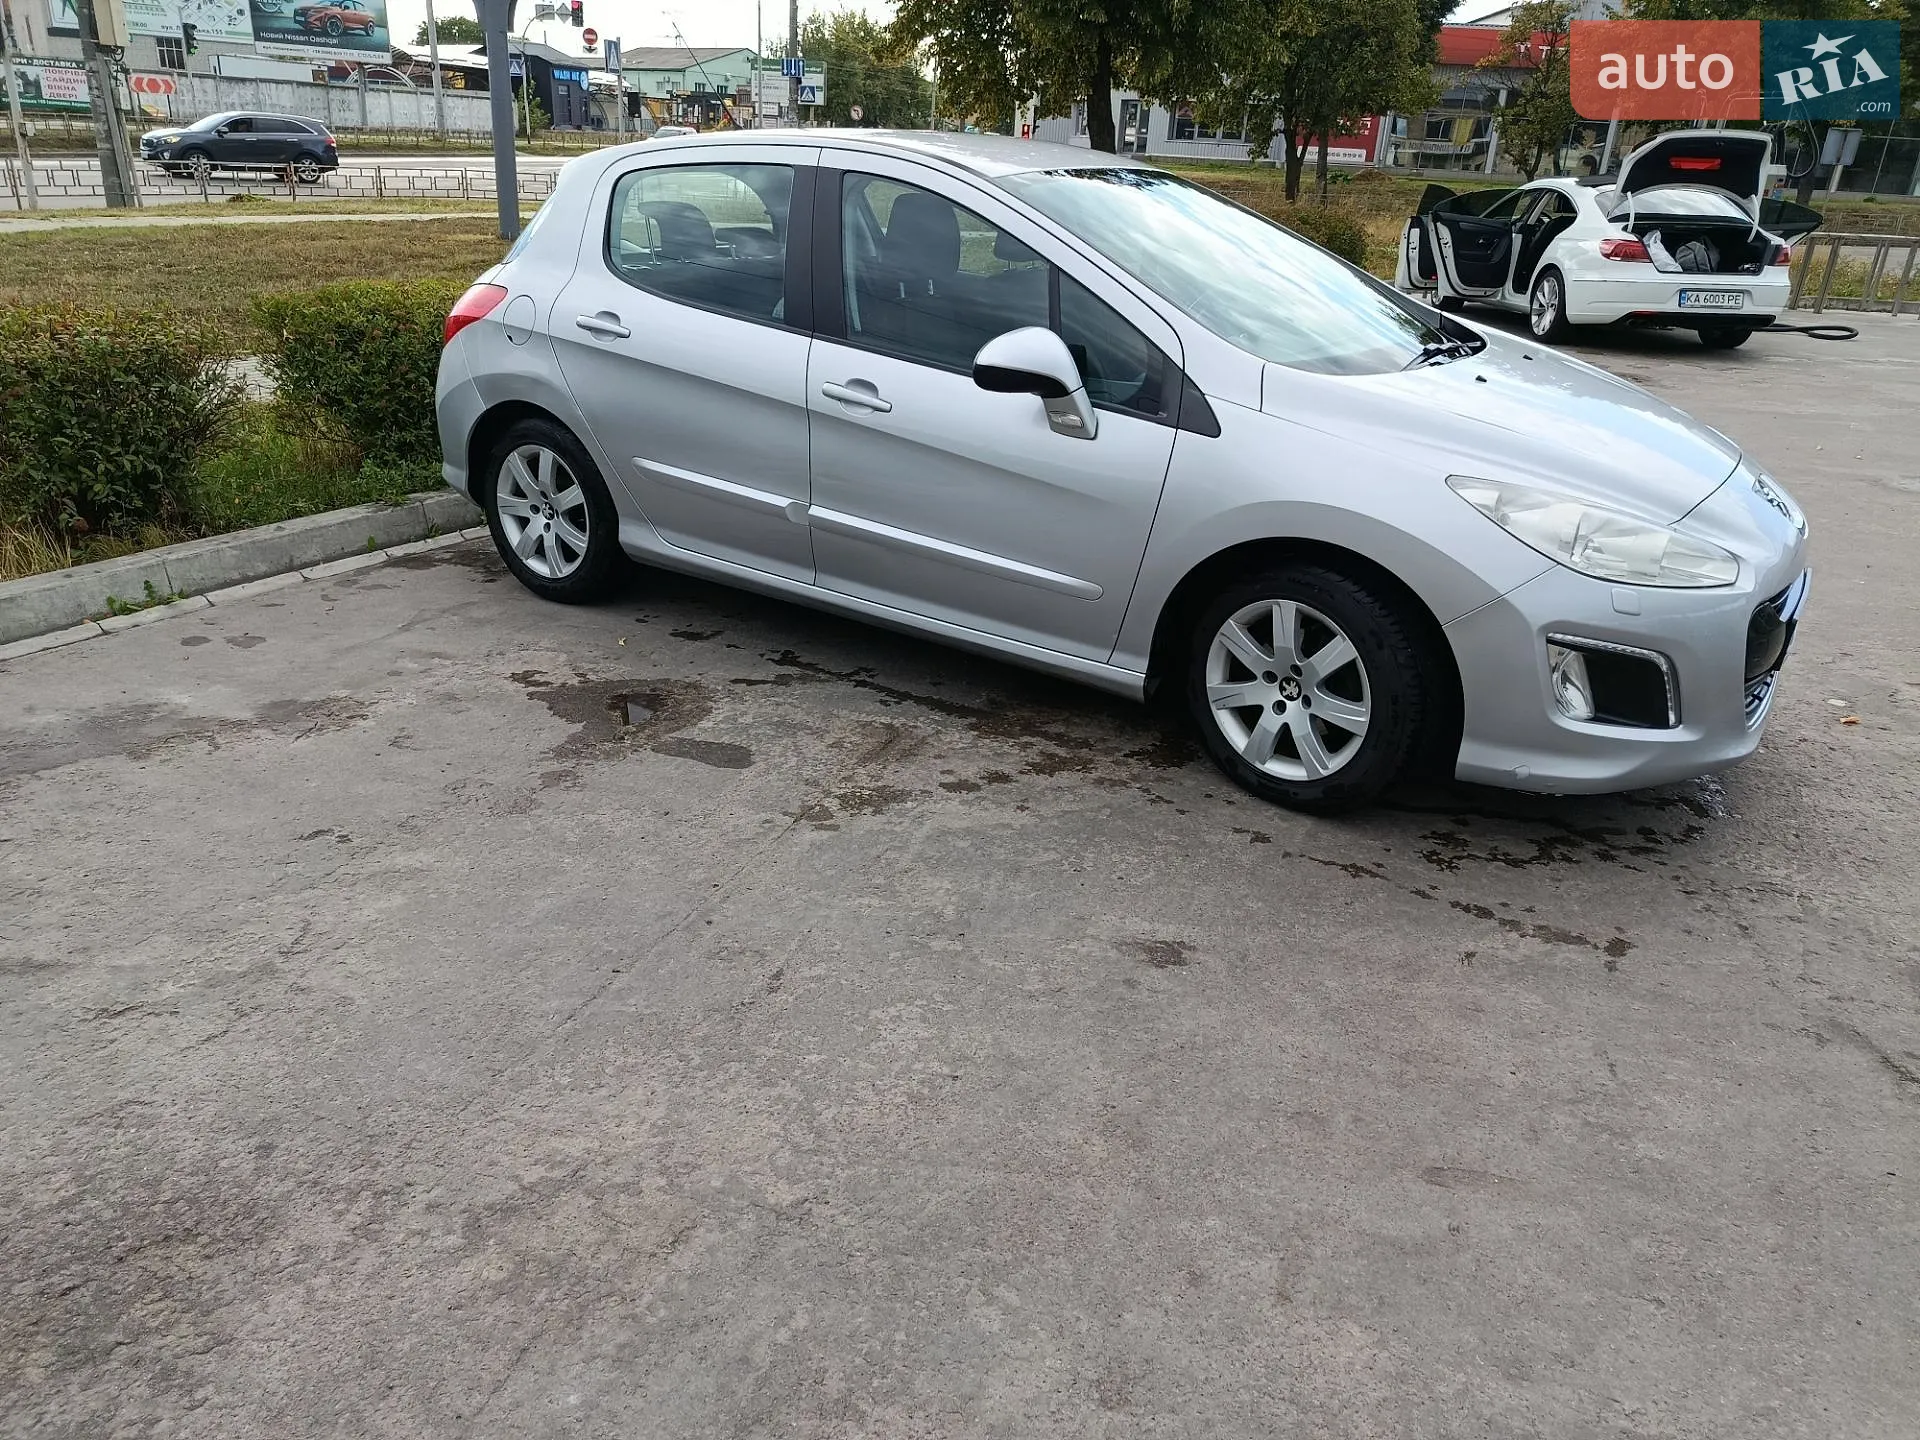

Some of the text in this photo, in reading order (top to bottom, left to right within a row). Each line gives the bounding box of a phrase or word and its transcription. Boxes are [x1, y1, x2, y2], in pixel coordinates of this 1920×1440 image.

[260, 31, 339, 45] Новий Nissan Qashqai
[33, 59, 78, 68] ДОСТАВКА
[44, 68, 86, 76] ПОКРІВЛ
[46, 77, 87, 85] САЙДИН
[47, 84, 77, 92] ВІКНА
[1686, 293, 1741, 305] KA 6003 PE
